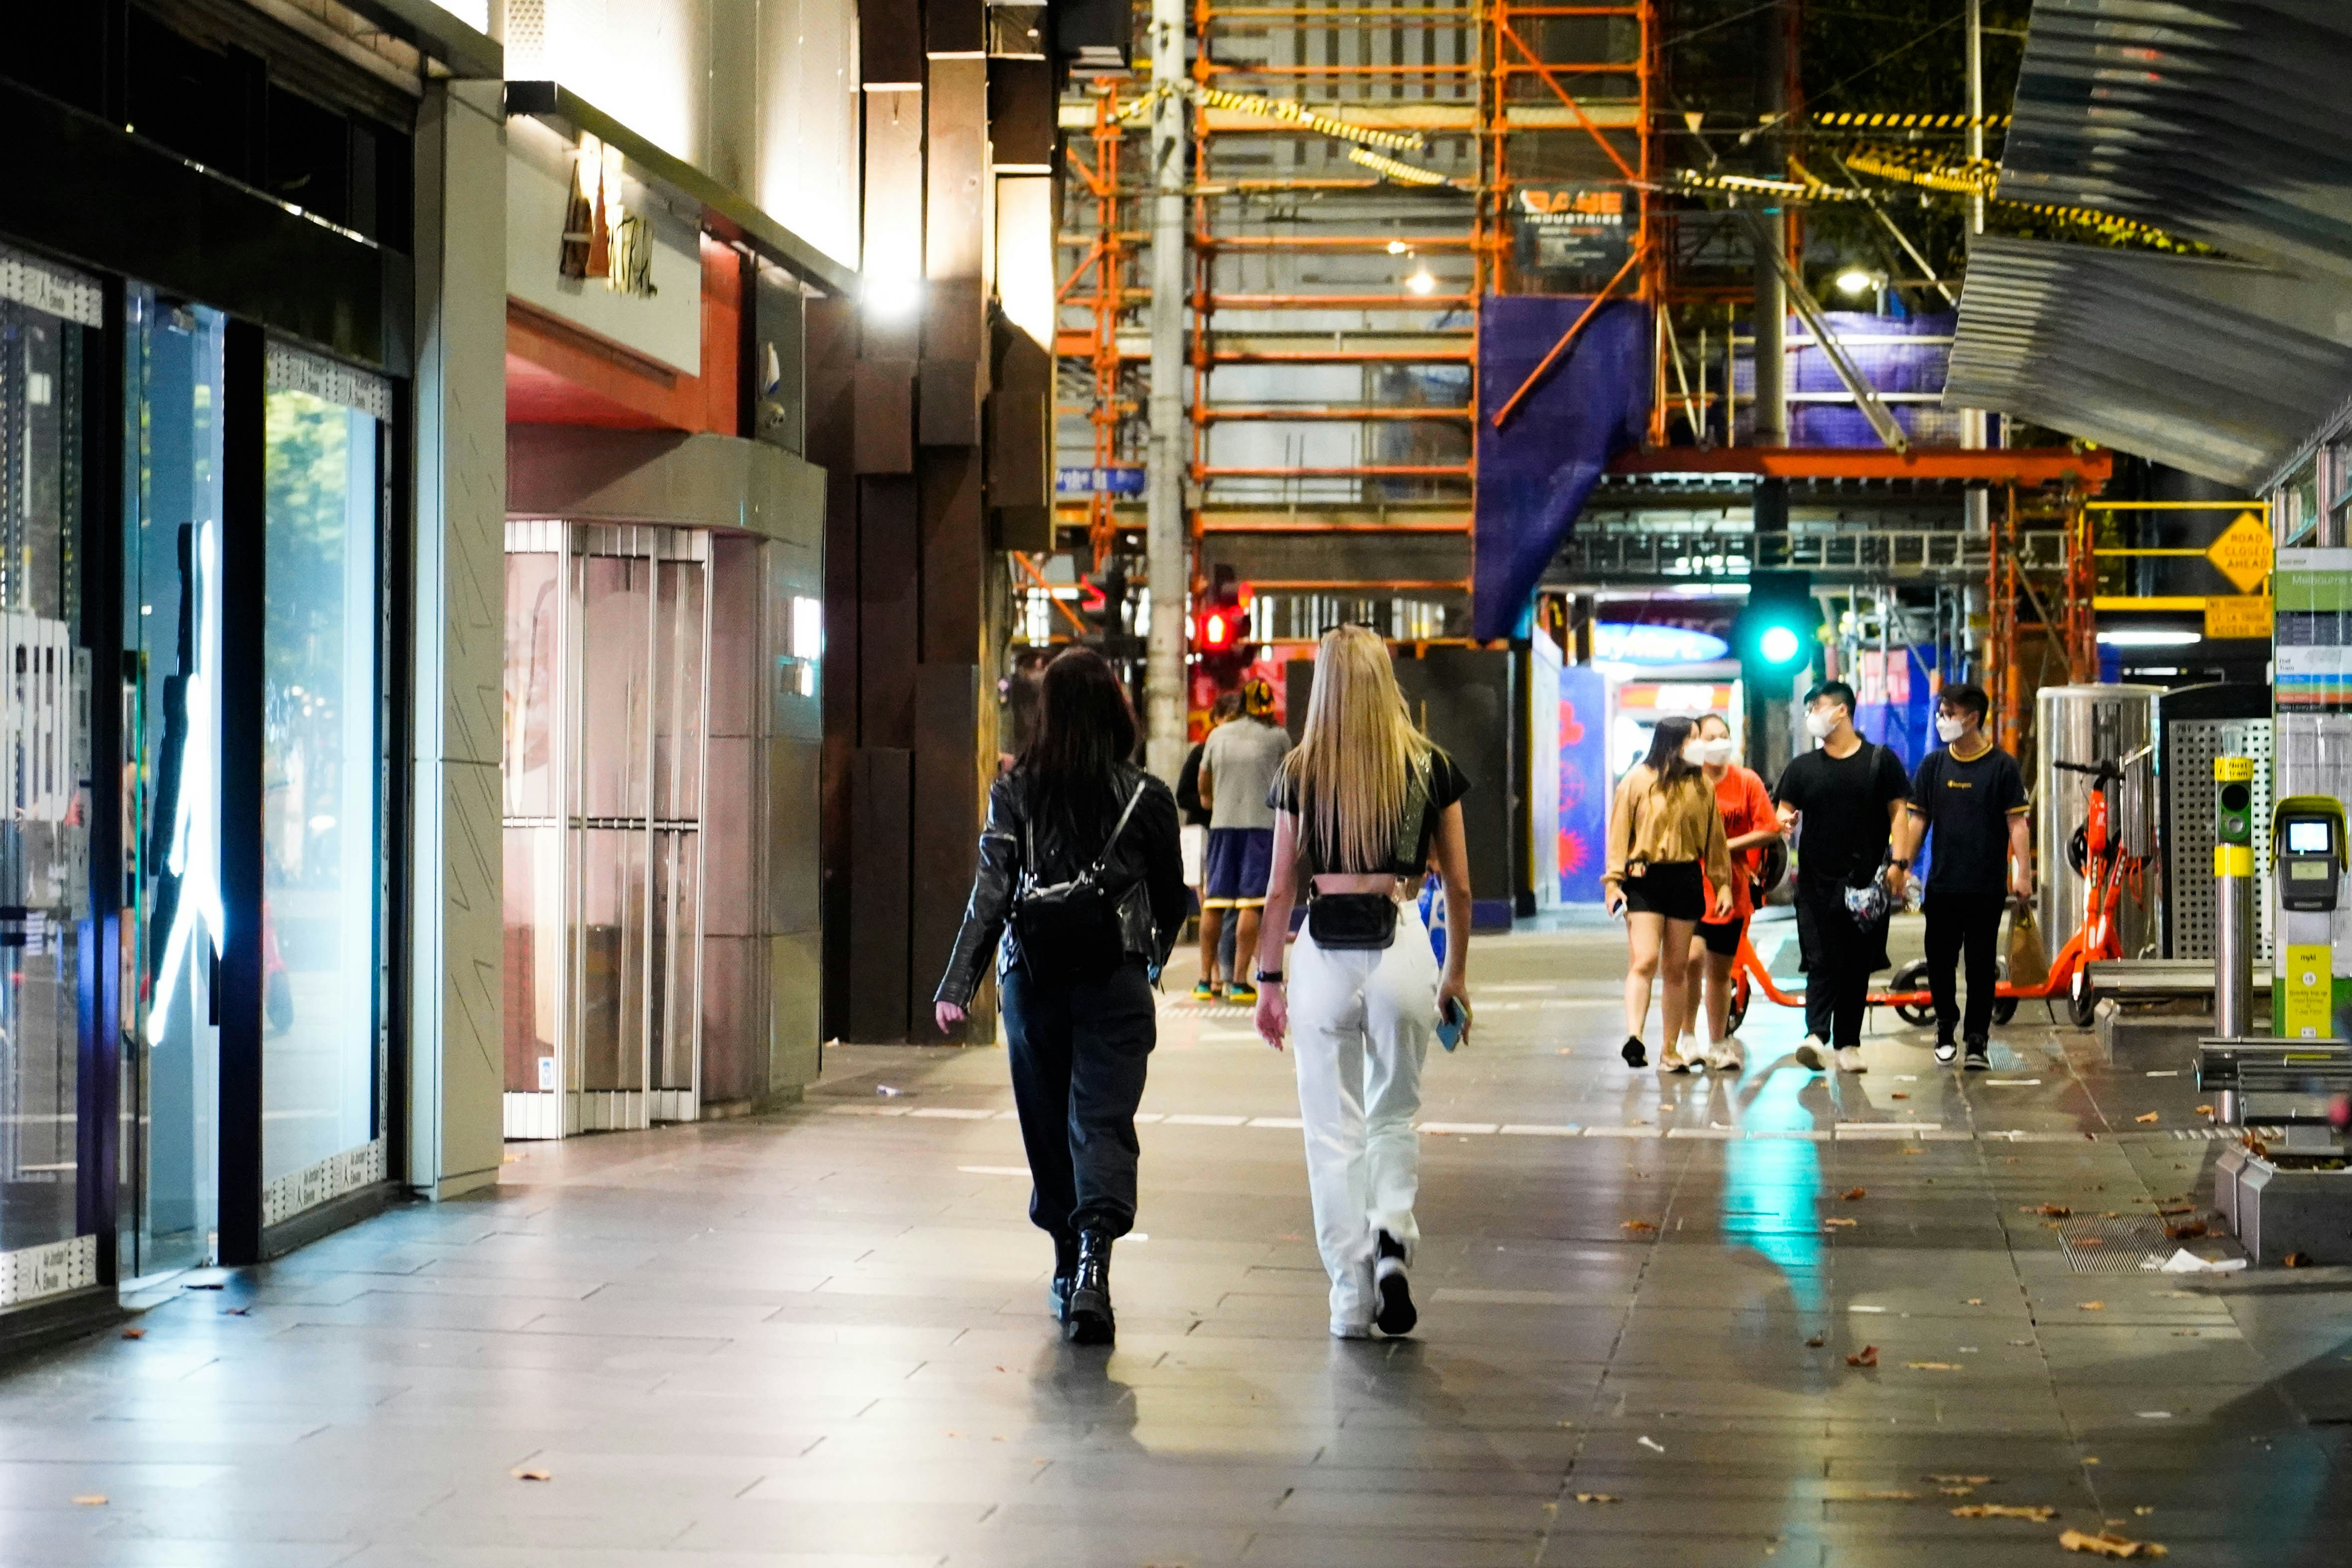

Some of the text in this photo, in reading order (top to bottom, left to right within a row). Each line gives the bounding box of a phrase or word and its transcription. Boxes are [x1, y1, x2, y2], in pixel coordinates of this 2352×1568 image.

[2231, 533, 2262, 543] ROAD
[2224, 546, 2269, 557] CLOSED
[2227, 558, 2267, 569] AHEAD
